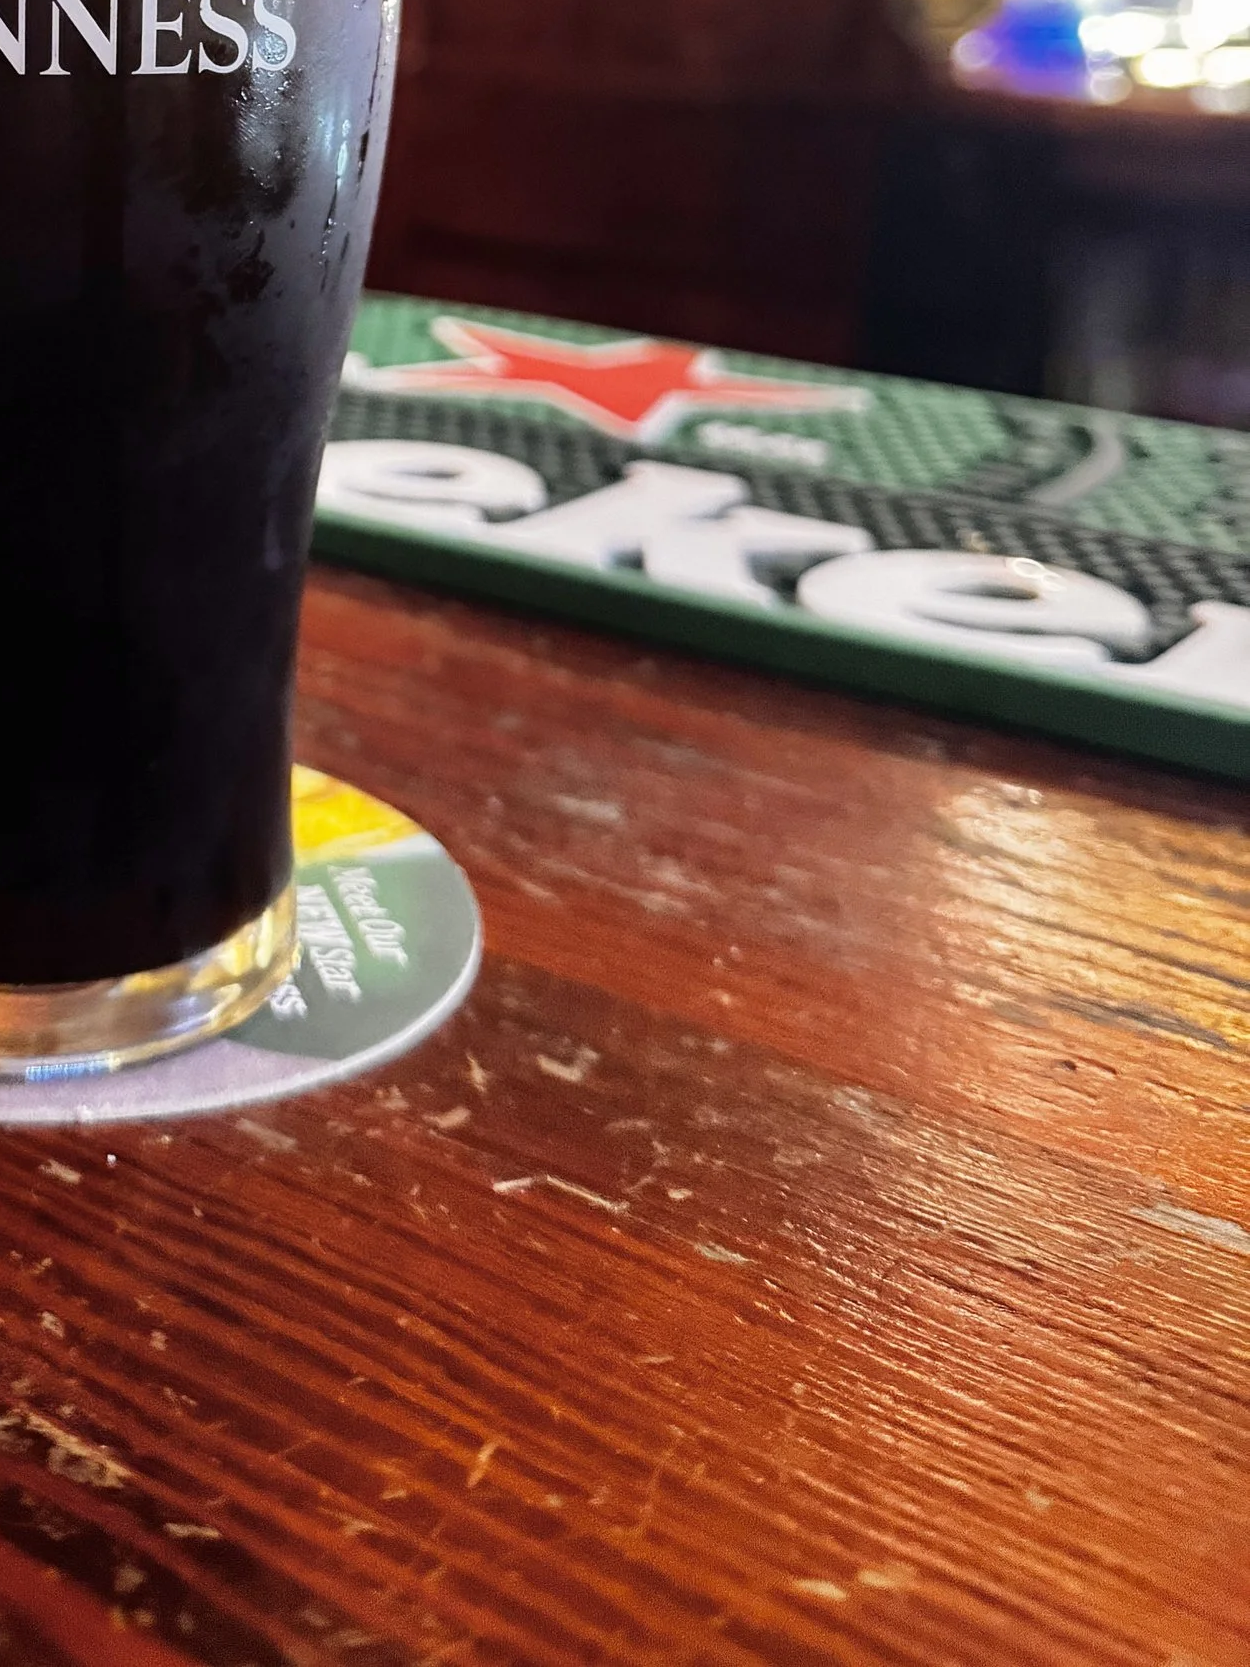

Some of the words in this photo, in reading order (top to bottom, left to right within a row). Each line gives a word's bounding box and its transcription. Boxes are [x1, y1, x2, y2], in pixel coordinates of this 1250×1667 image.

[296, 884, 354, 949] NEW
[327, 864, 391, 919] Meet
[358, 917, 409, 968] Our
[309, 946, 363, 1003] Star
